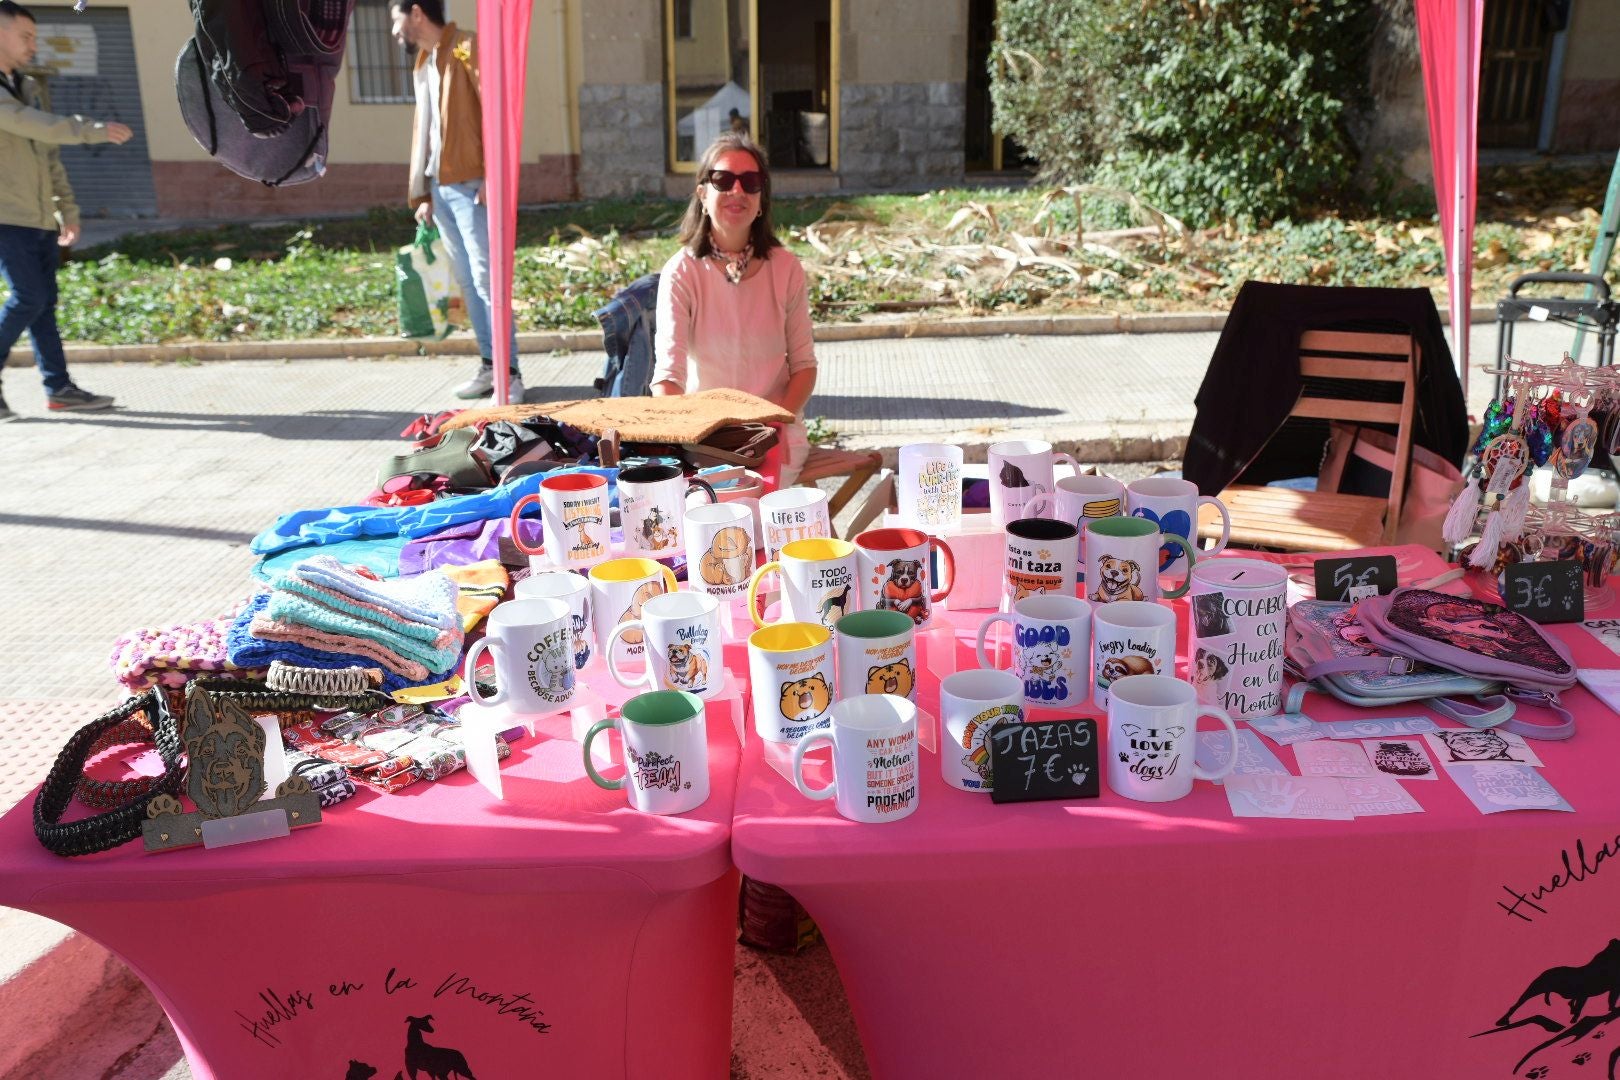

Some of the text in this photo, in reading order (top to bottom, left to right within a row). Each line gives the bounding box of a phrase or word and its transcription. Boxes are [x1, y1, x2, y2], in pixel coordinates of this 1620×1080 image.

[819, 566, 847, 579] TODO
[1027, 560, 1063, 573] taza
[811, 574, 852, 589] ES MEJOR
[1015, 623, 1071, 648] GOOD
[1242, 663, 1280, 688] en la
[527, 670, 555, 703] BECAUSE
[1024, 676, 1069, 701] IBES
[867, 729, 915, 749] ANY WOMAN
[992, 721, 1091, 755] TAZAS
[1147, 728, 1160, 738] I
[1130, 738, 1174, 751] LOVE
[873, 754, 910, 769] Mother
[867, 770, 883, 780] BUT
[867, 779, 896, 788] SOMEONE
[867, 785, 915, 808] PODENCO
[234, 967, 552, 1048] Huellas en la Montaña
